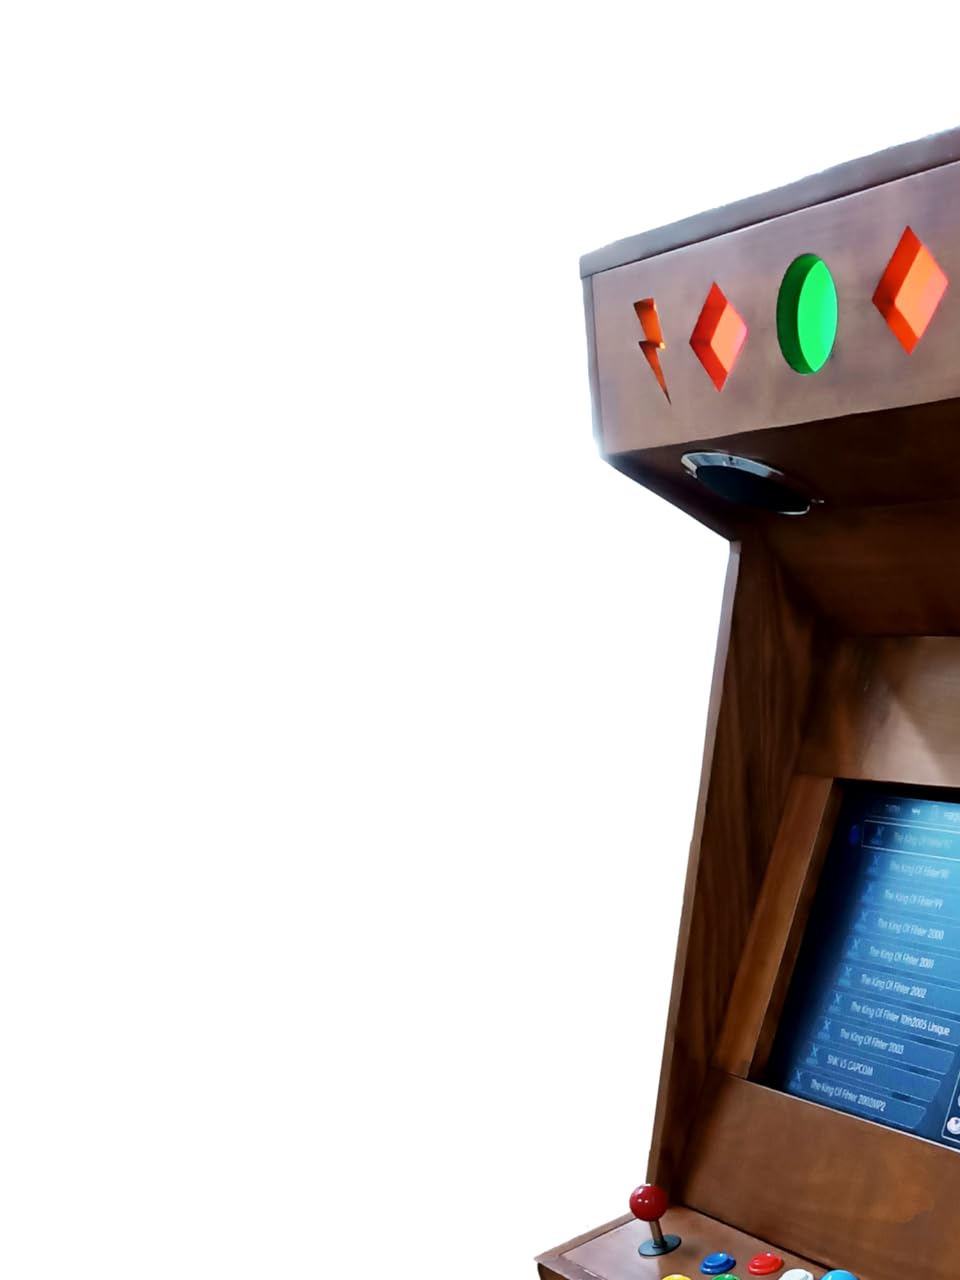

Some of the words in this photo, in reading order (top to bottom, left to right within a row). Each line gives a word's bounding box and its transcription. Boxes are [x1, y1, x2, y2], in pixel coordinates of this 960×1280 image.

[871, 976, 885, 991] King
[861, 1005, 876, 1019] King
[850, 1031, 864, 1046] King
[847, 1060, 874, 1077] CAPCOM
